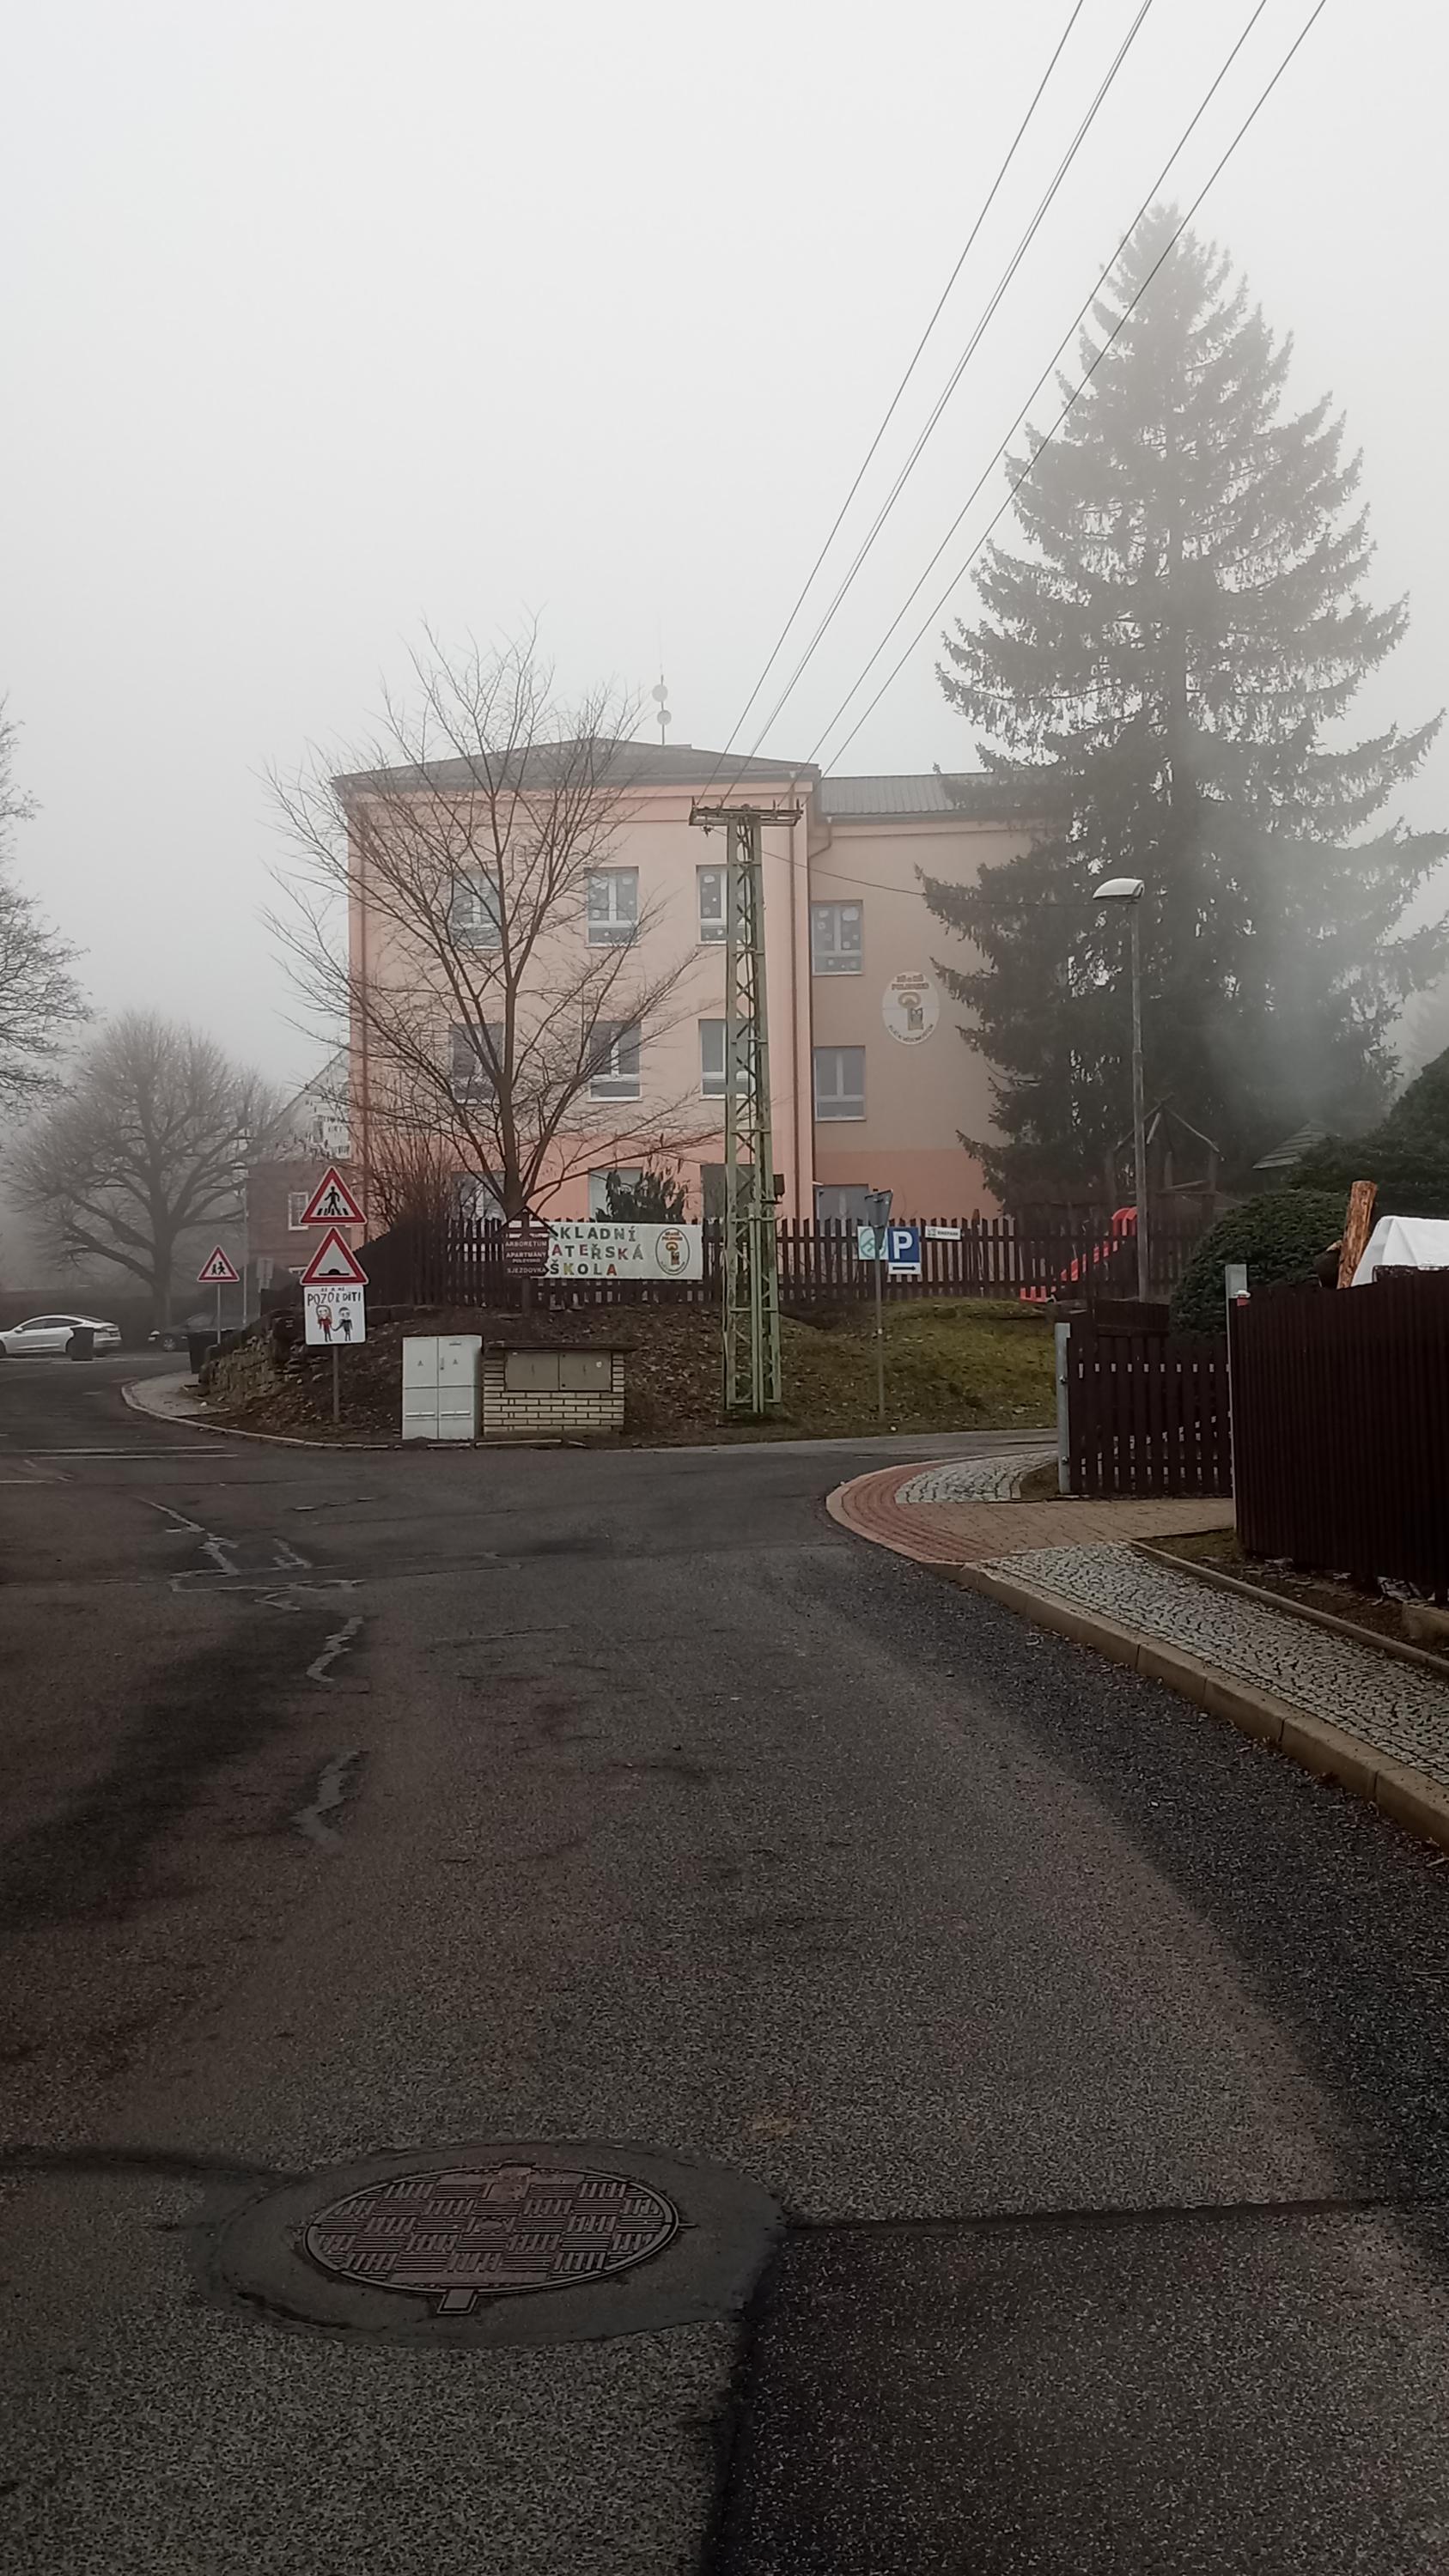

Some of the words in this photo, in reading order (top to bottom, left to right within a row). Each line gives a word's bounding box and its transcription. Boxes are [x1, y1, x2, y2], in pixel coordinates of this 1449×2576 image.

[551, 1243, 643, 1261] ATEŘSKÁ
[893, 1230, 913, 1260] P
[550, 1259, 618, 1276] ŠKOLA
